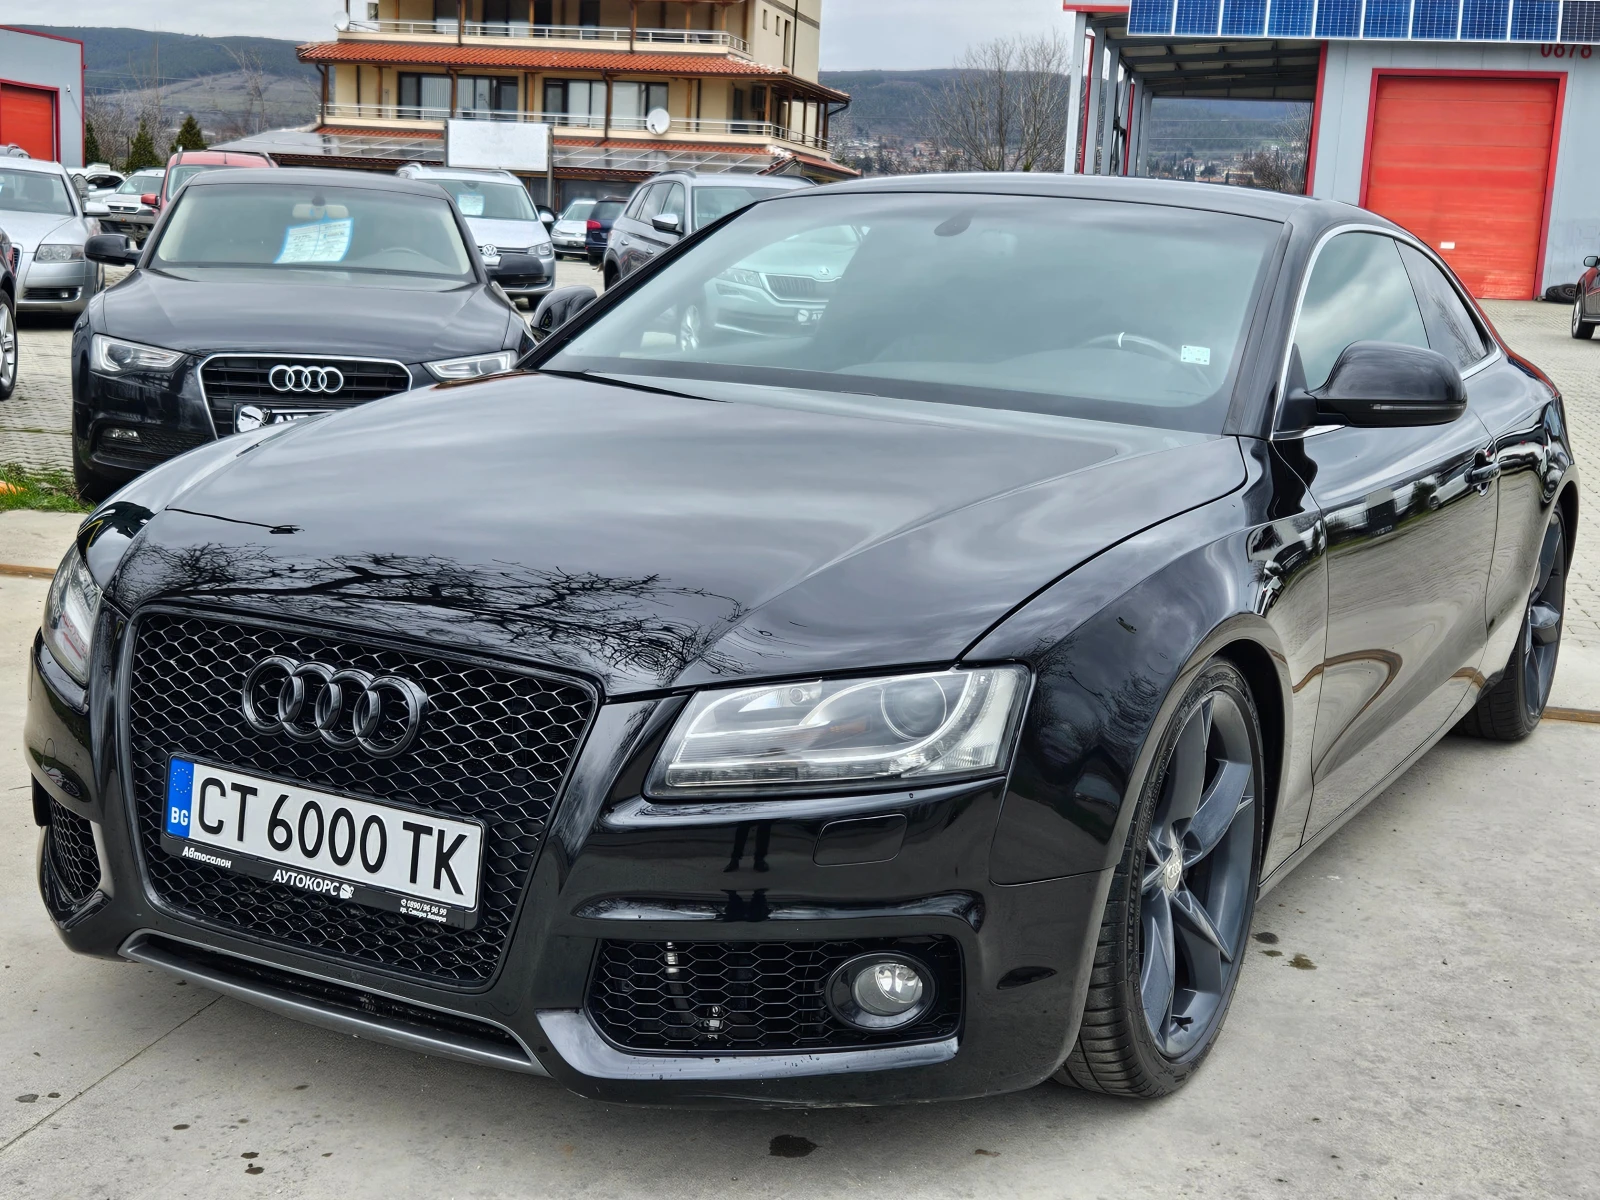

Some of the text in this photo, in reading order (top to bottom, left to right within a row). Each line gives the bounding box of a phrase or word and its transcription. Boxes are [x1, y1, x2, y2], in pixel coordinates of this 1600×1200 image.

[170, 806, 189, 826] BG
[267, 793, 387, 874] 6000
[182, 846, 232, 869] Автосалон
[272, 869, 340, 896] АУТОКОРС
